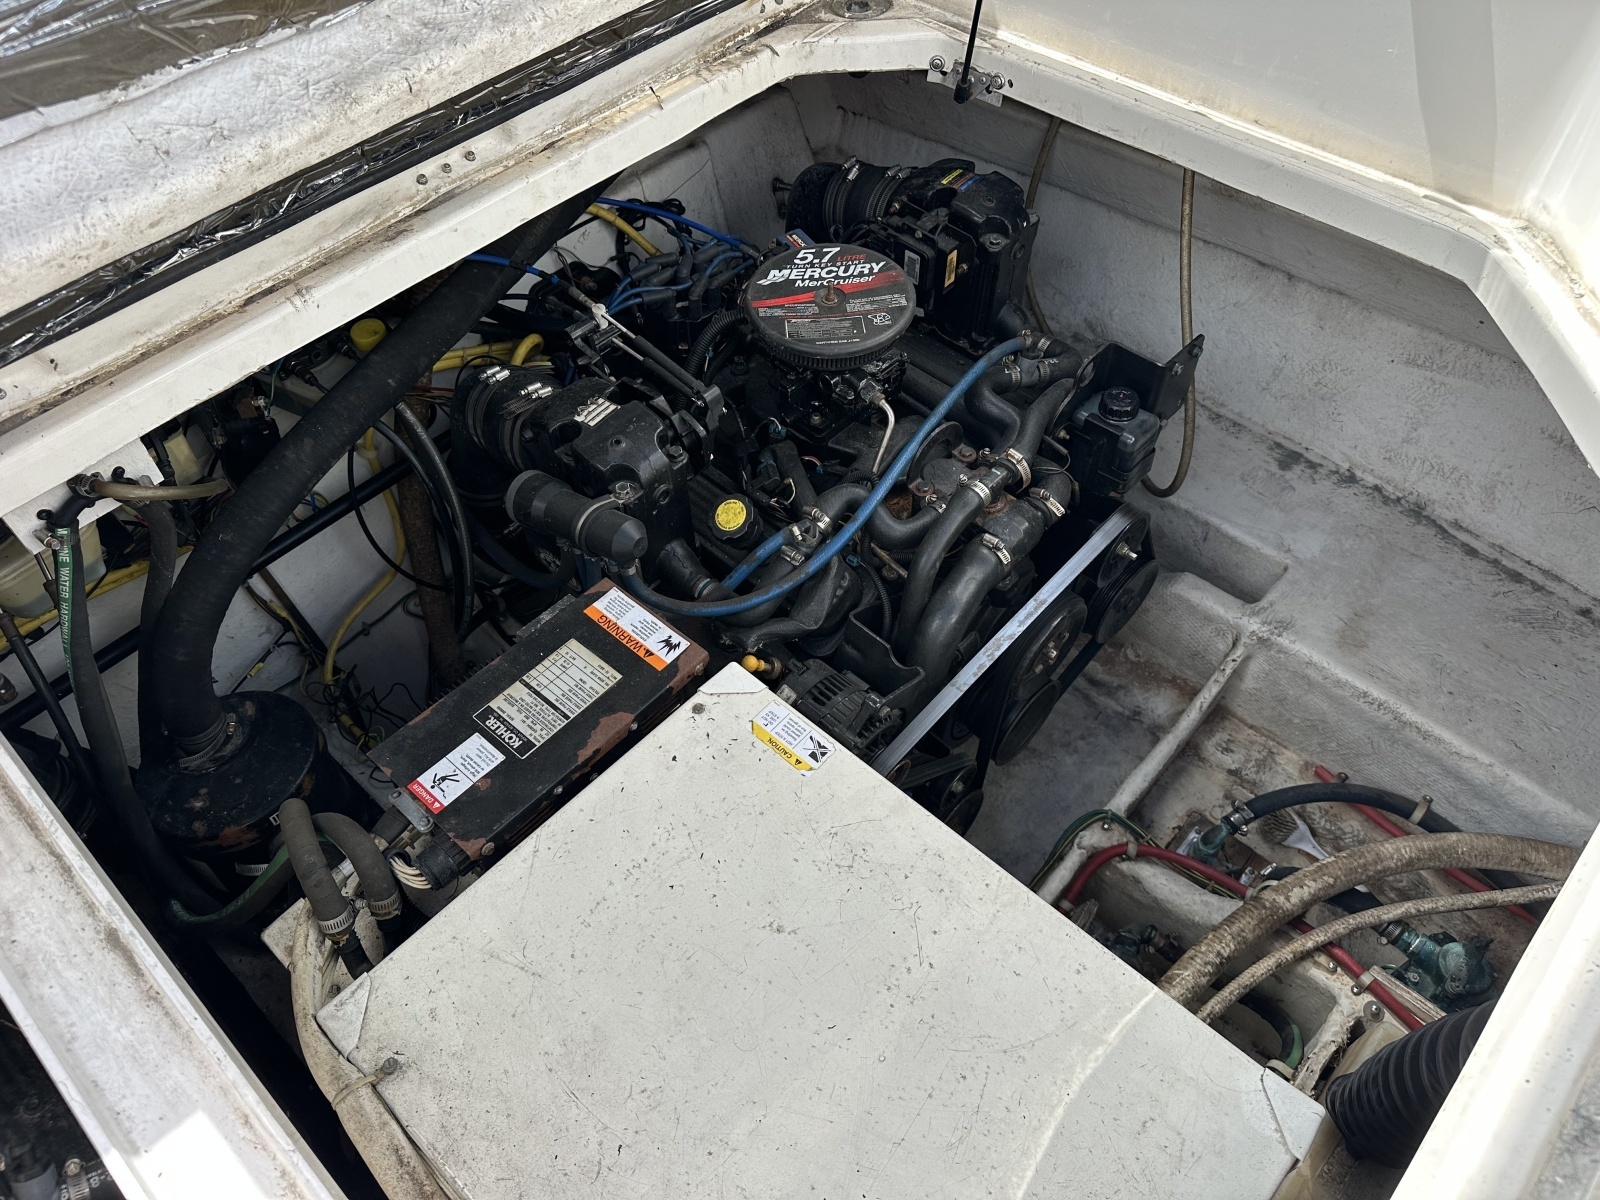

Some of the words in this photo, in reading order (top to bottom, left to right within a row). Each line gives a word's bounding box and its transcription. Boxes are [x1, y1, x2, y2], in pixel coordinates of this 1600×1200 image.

[794, 247, 840, 264] 5.7
[837, 254, 866, 262] LITRE
[757, 261, 887, 285] MERCURY
[795, 275, 875, 287] MerCruiser
[59, 568, 70, 599] WATER
[595, 614, 644, 652] WARNING
[483, 715, 523, 748] KOHLER
[766, 737, 792, 759] CAUTION
[412, 782, 434, 803] DANGER
